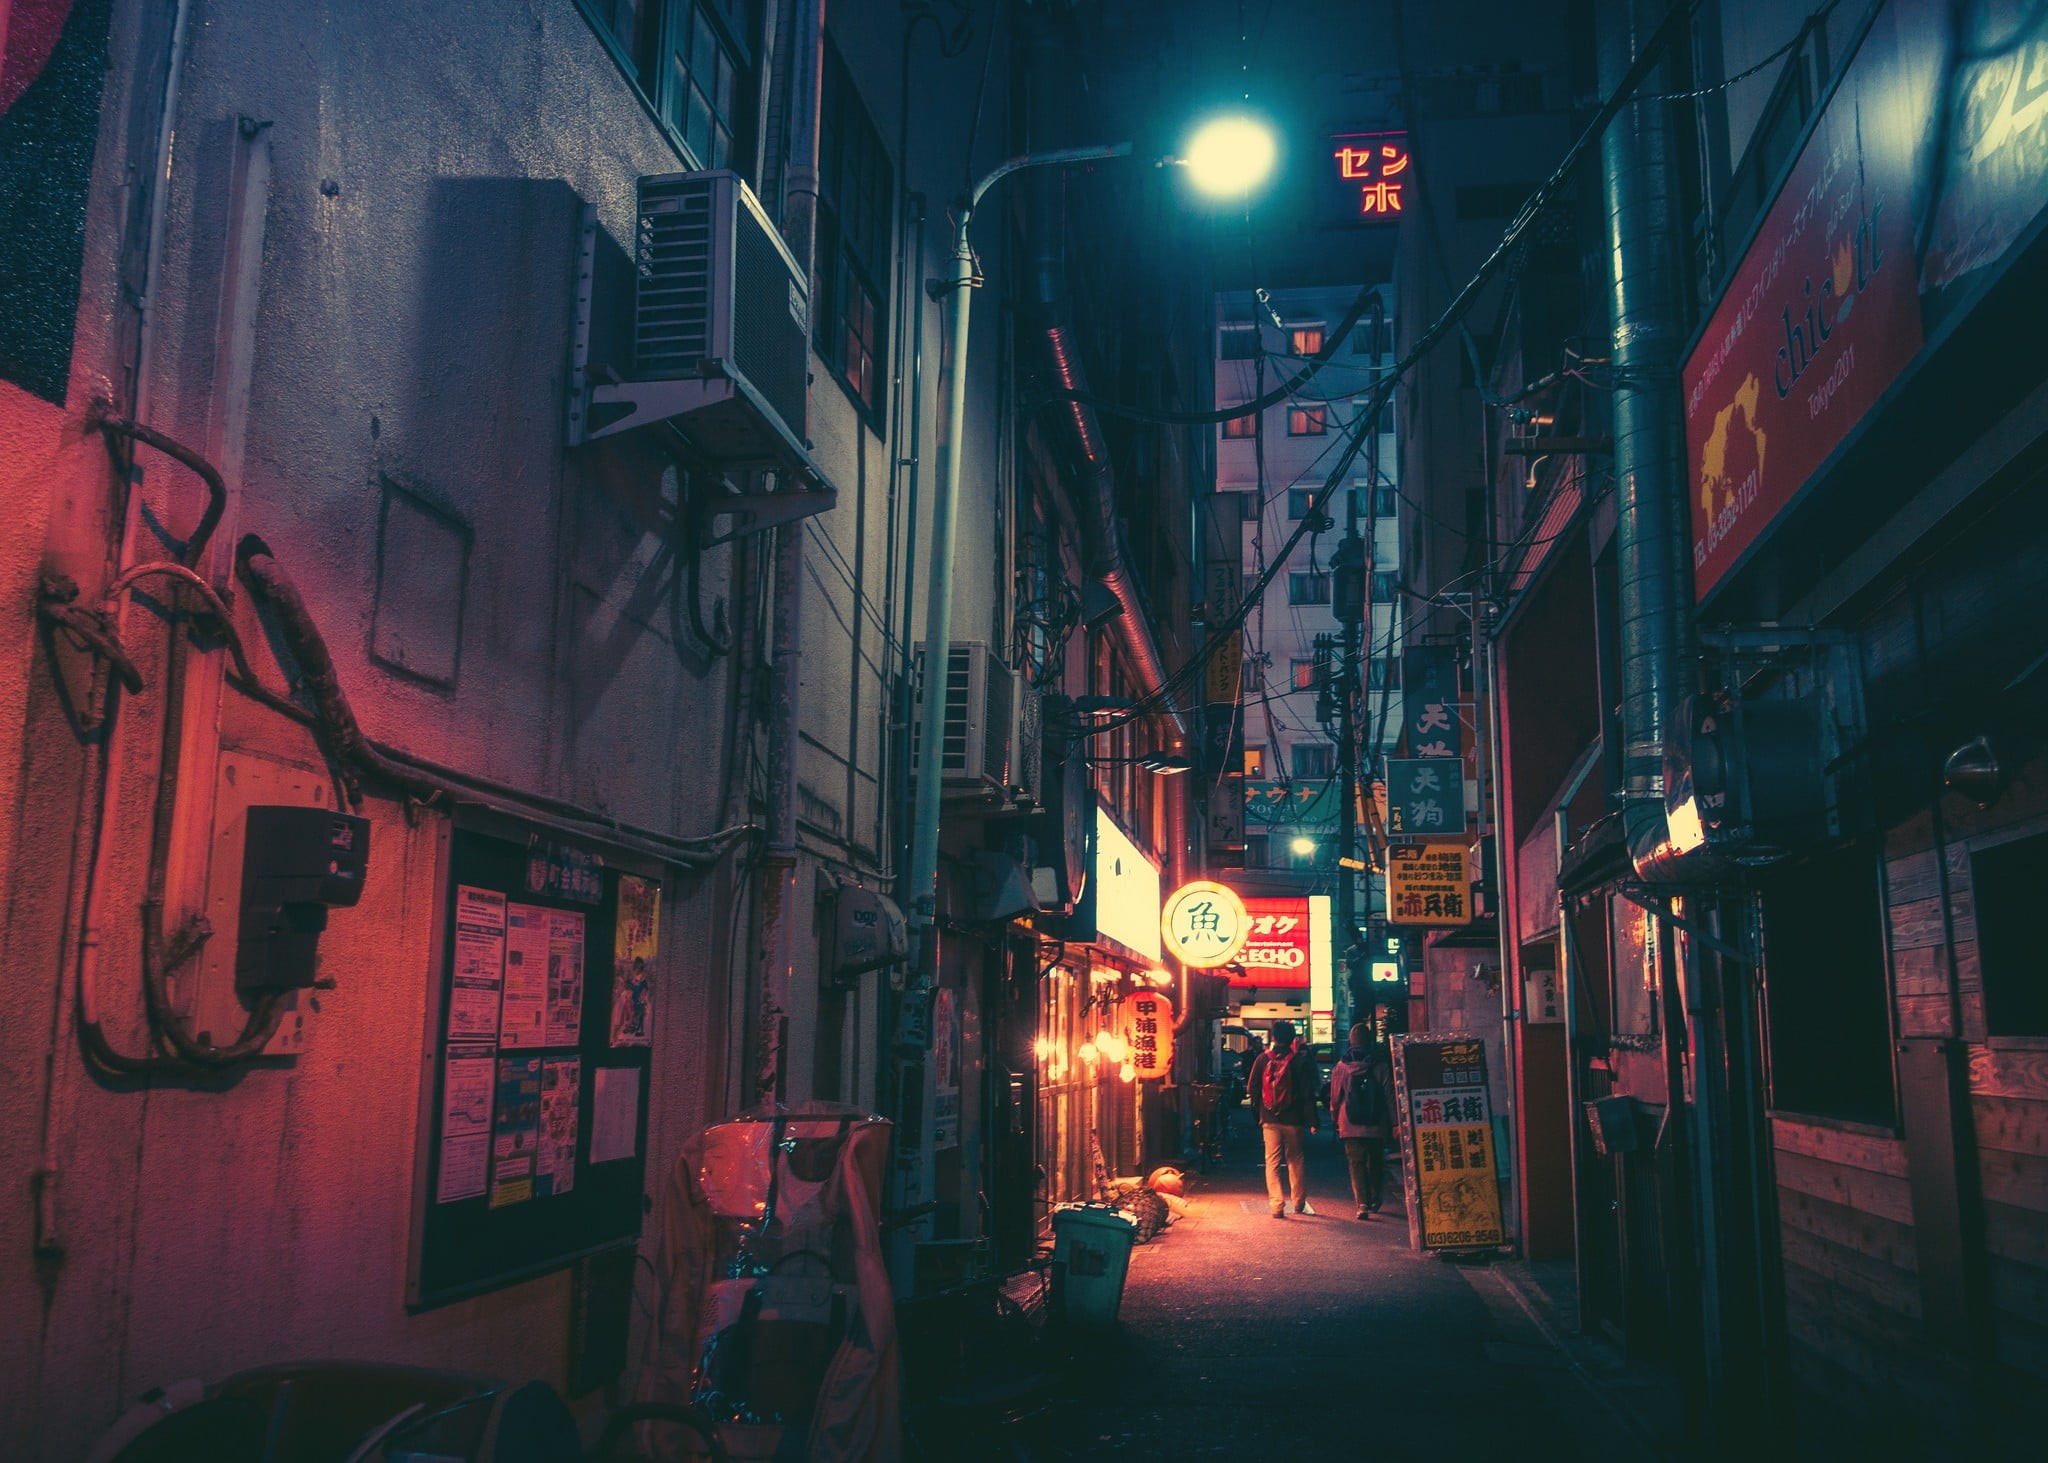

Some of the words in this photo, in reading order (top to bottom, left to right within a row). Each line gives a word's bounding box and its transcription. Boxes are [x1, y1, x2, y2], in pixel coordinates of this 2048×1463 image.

[1334, 147, 1408, 178] セン
[1410, 768, 1444, 828] 天狗
[1404, 892, 1463, 917] 赤兵衛
[1181, 902, 1231, 944] 魚
[1134, 1002, 1159, 1069] 甲浦漁港
[1423, 1096, 1483, 1124] 赤兵衛
